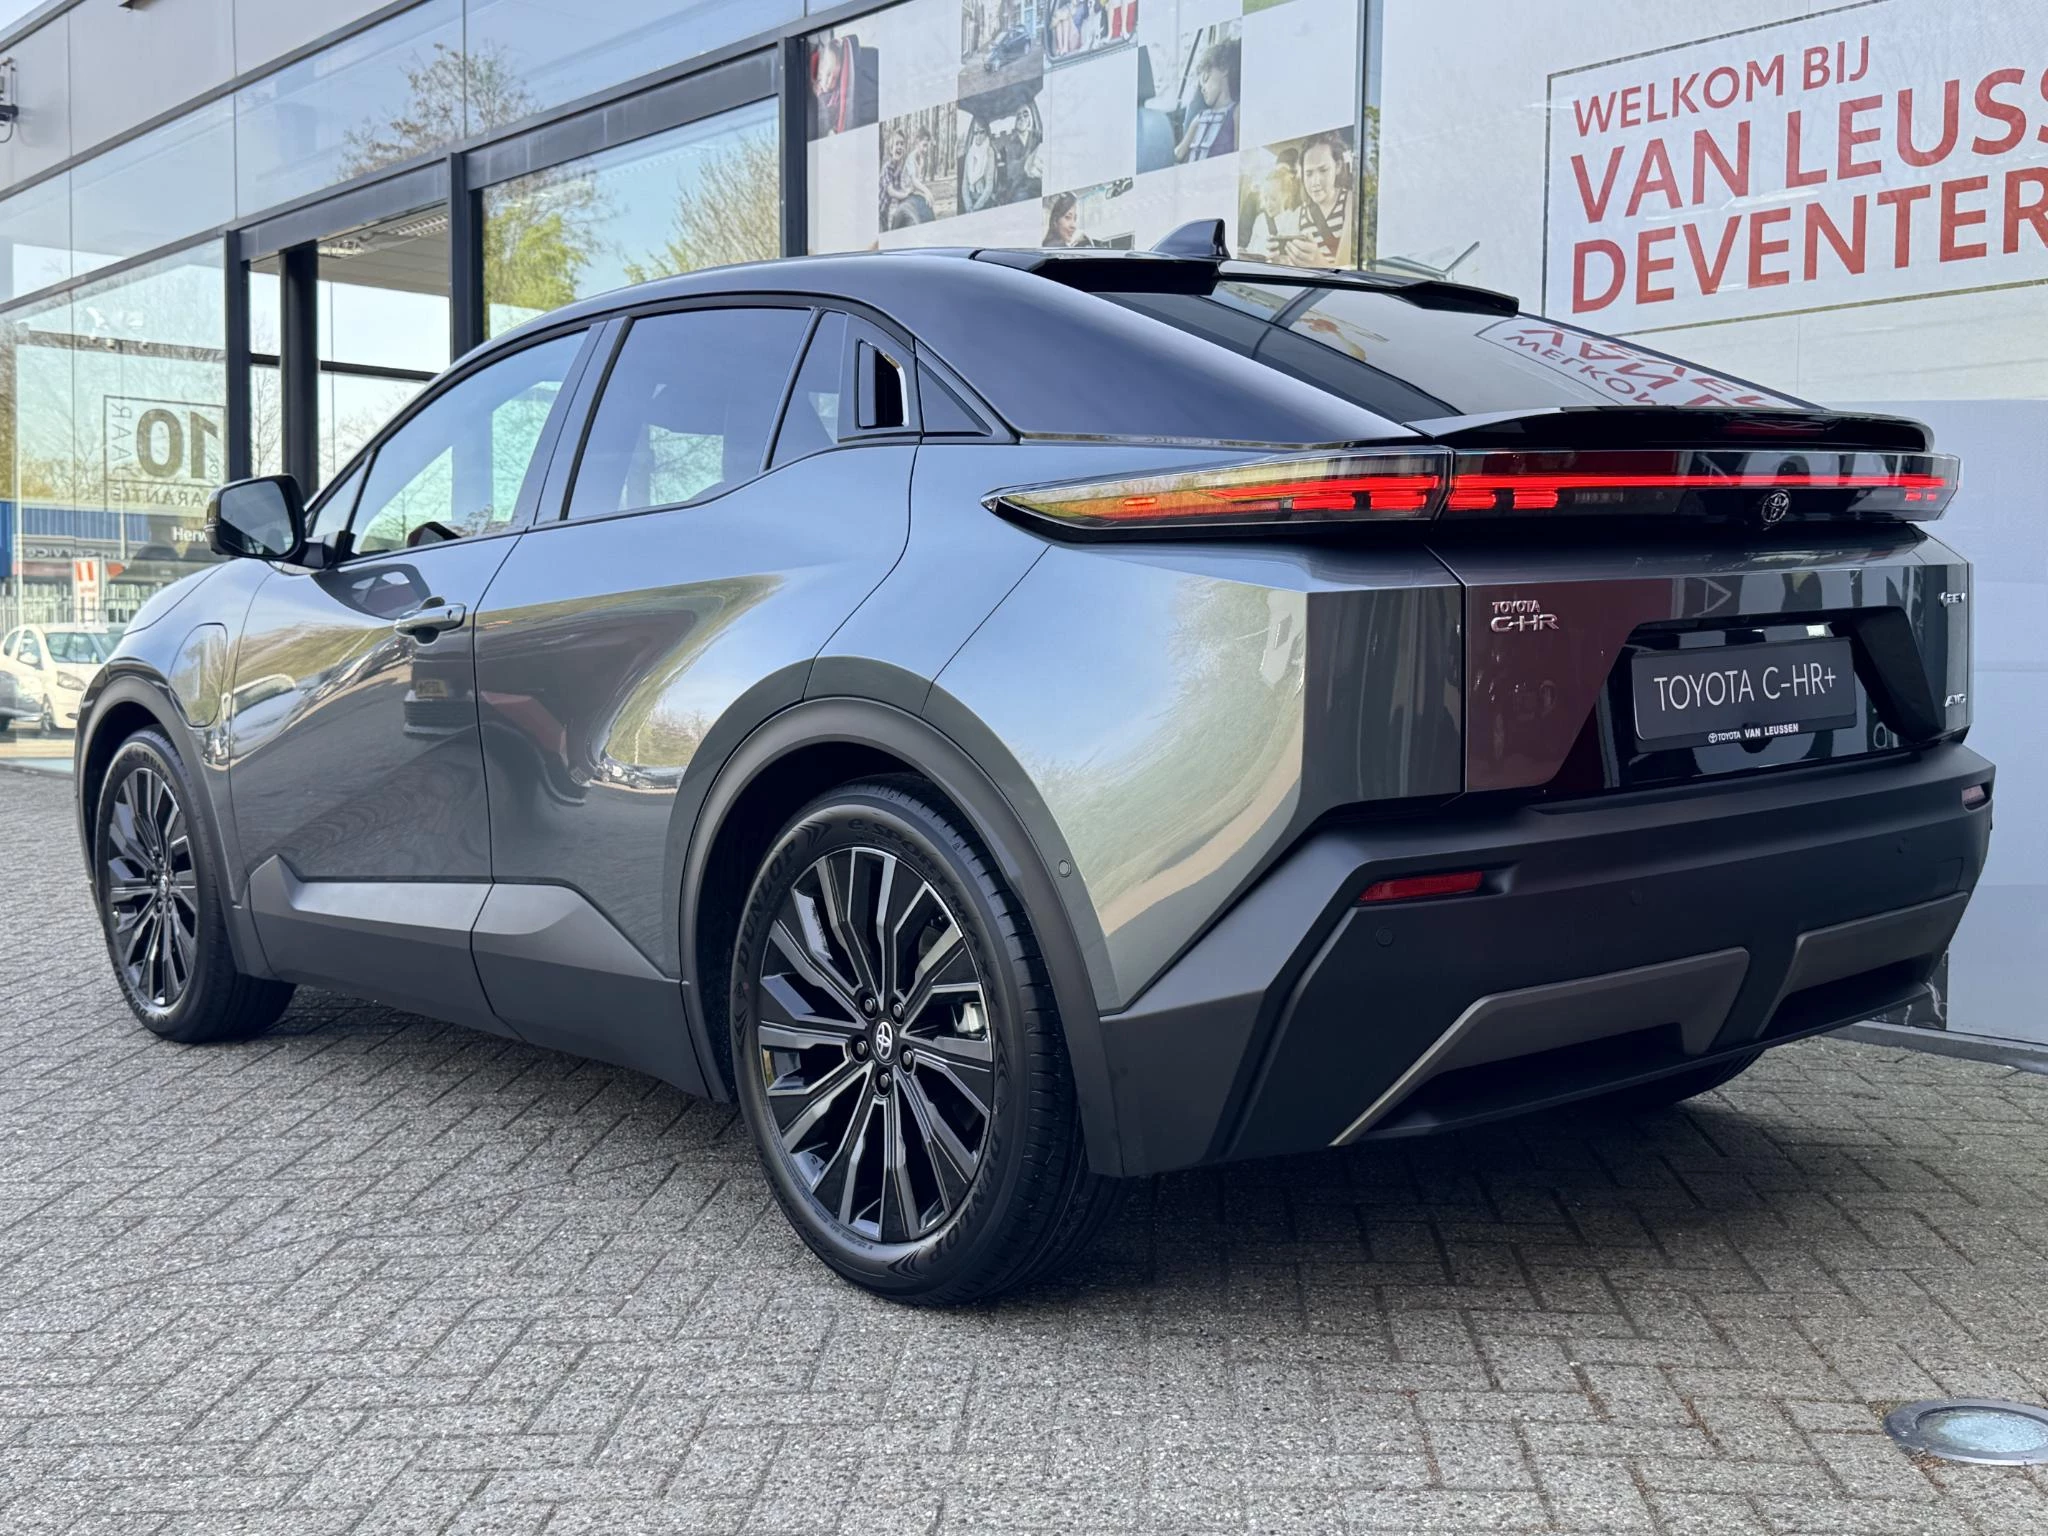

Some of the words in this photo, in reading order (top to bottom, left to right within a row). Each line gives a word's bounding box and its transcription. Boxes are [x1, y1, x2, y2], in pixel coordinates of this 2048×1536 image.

[1573, 54, 1784, 137] WELKOM
[1803, 35, 1870, 91] BIJ
[1570, 120, 1751, 223] VAN
[1786, 68, 2048, 188] LEUS
[1572, 166, 2048, 314] DEVENTER
[1492, 600, 1540, 614] TOYOTA
[1654, 669, 1755, 712] TOYOTA
[1762, 662, 1837, 700] C-HR+
[1718, 731, 1741, 741] TOYOTA
[1744, 727, 1761, 739] VAN
[1764, 723, 1799, 736] LEUSSEN
[736, 835, 798, 975] DUNLOP
[926, 1130, 1006, 1265] DUNLOP
